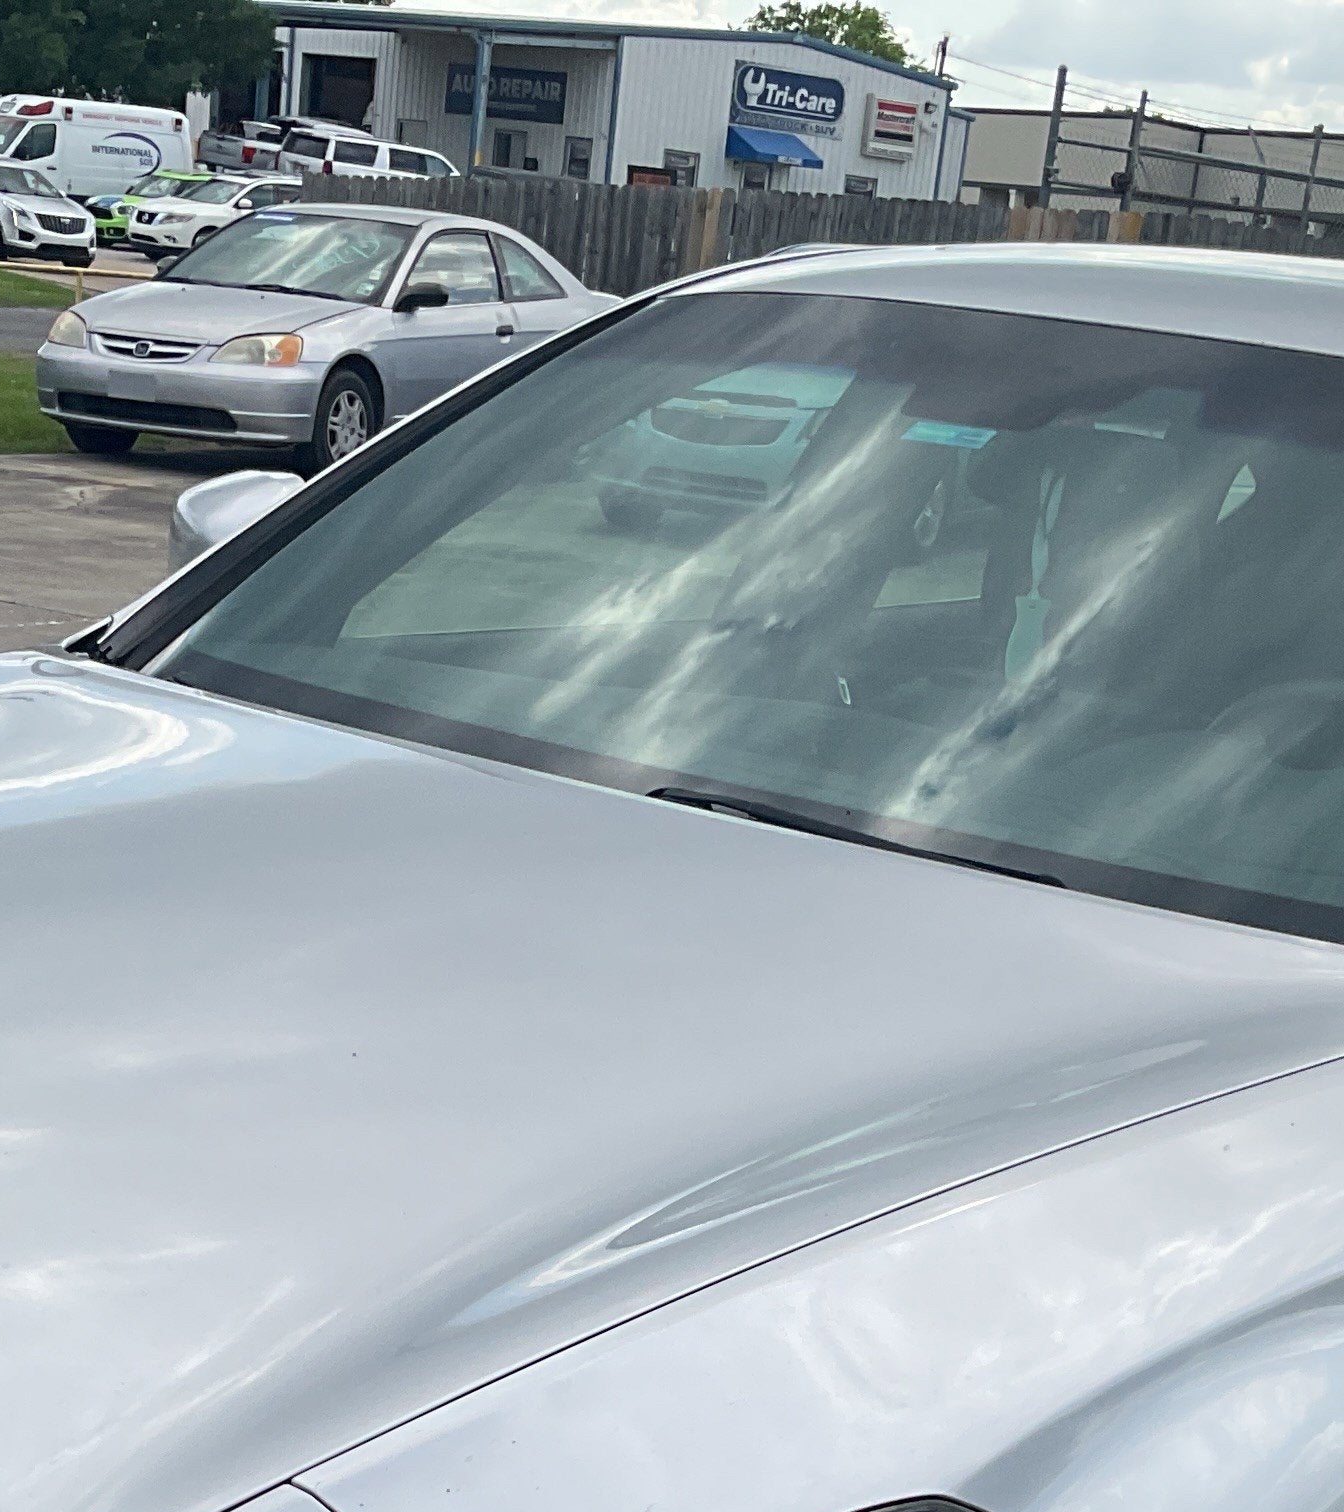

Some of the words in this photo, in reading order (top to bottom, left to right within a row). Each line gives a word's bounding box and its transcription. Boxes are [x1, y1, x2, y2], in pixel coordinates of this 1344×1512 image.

[499, 77, 562, 102] REPAIR
[765, 82, 836, 114] Tri-Care
[92, 145, 153, 157] INTERNATIONAL
